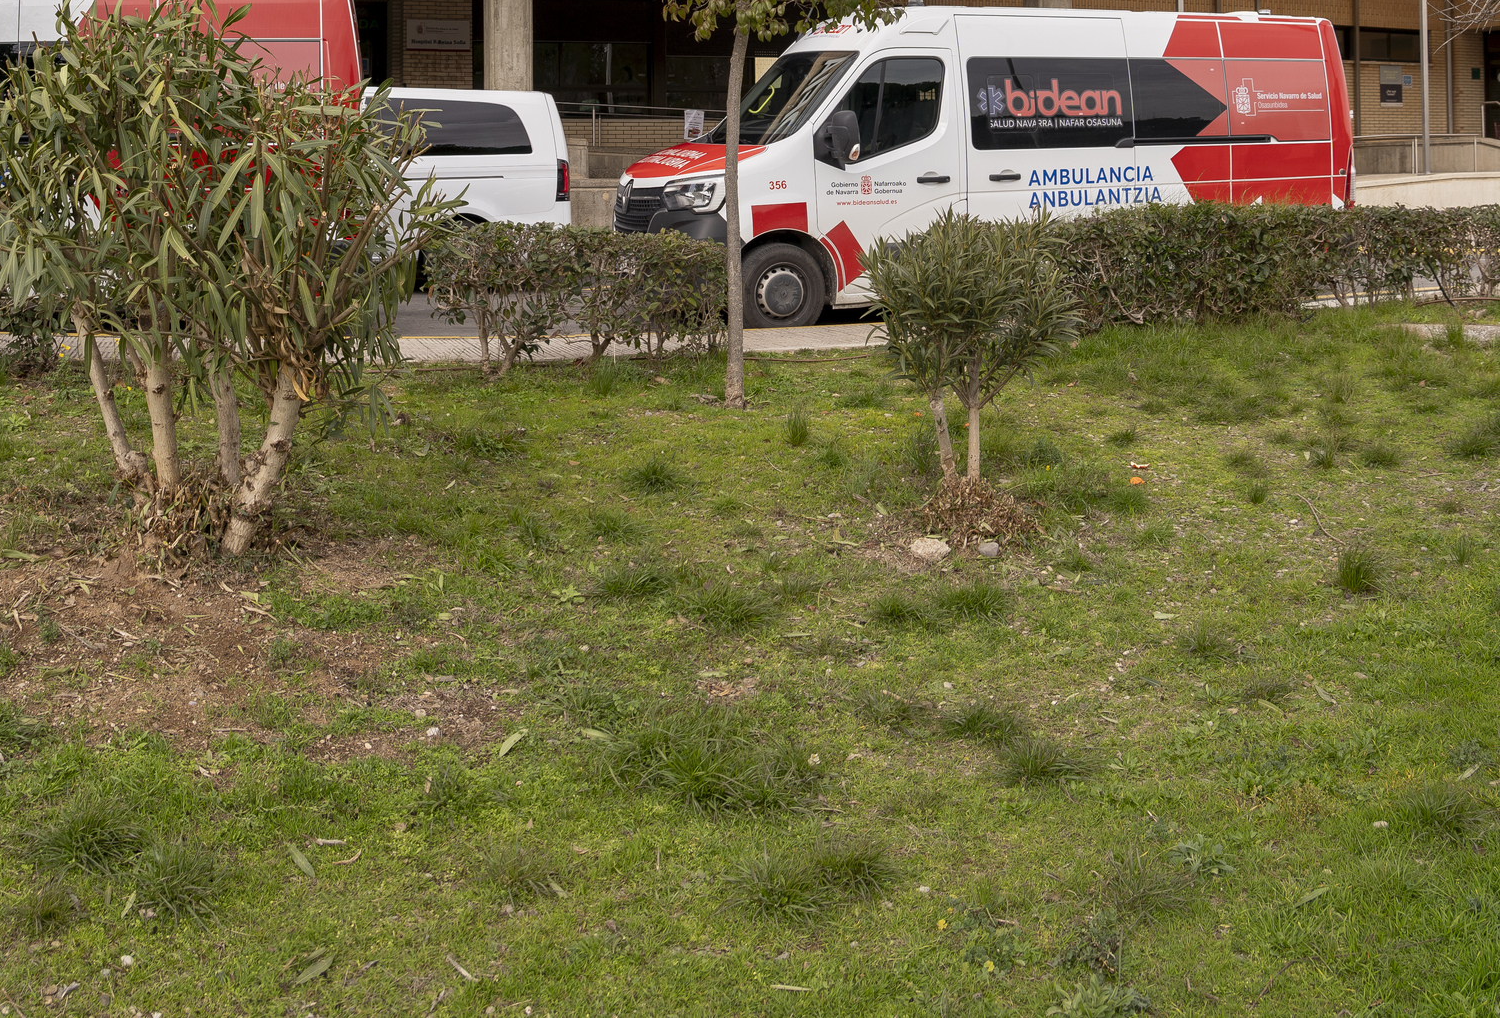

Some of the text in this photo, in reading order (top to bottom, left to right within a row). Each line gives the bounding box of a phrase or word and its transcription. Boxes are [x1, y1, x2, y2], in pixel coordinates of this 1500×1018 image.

[1004, 79, 1122, 116] bidean
[1256, 92, 1279, 100] Servicio
[1279, 92, 1299, 100] Navarro
[1307, 92, 1322, 100] Salud
[1257, 101, 1288, 109] Osasunbidea
[1017, 119, 1053, 128] NAVARRA
[1059, 119, 1085, 128] NAFAR
[1086, 118, 1123, 127] OSASUNA
[1028, 165, 1154, 187] AMBULANCIA
[769, 180, 787, 190] 356
[836, 198, 898, 206] www.bideansalud.es
[1028, 186, 1162, 209] ANBULANTZIA
